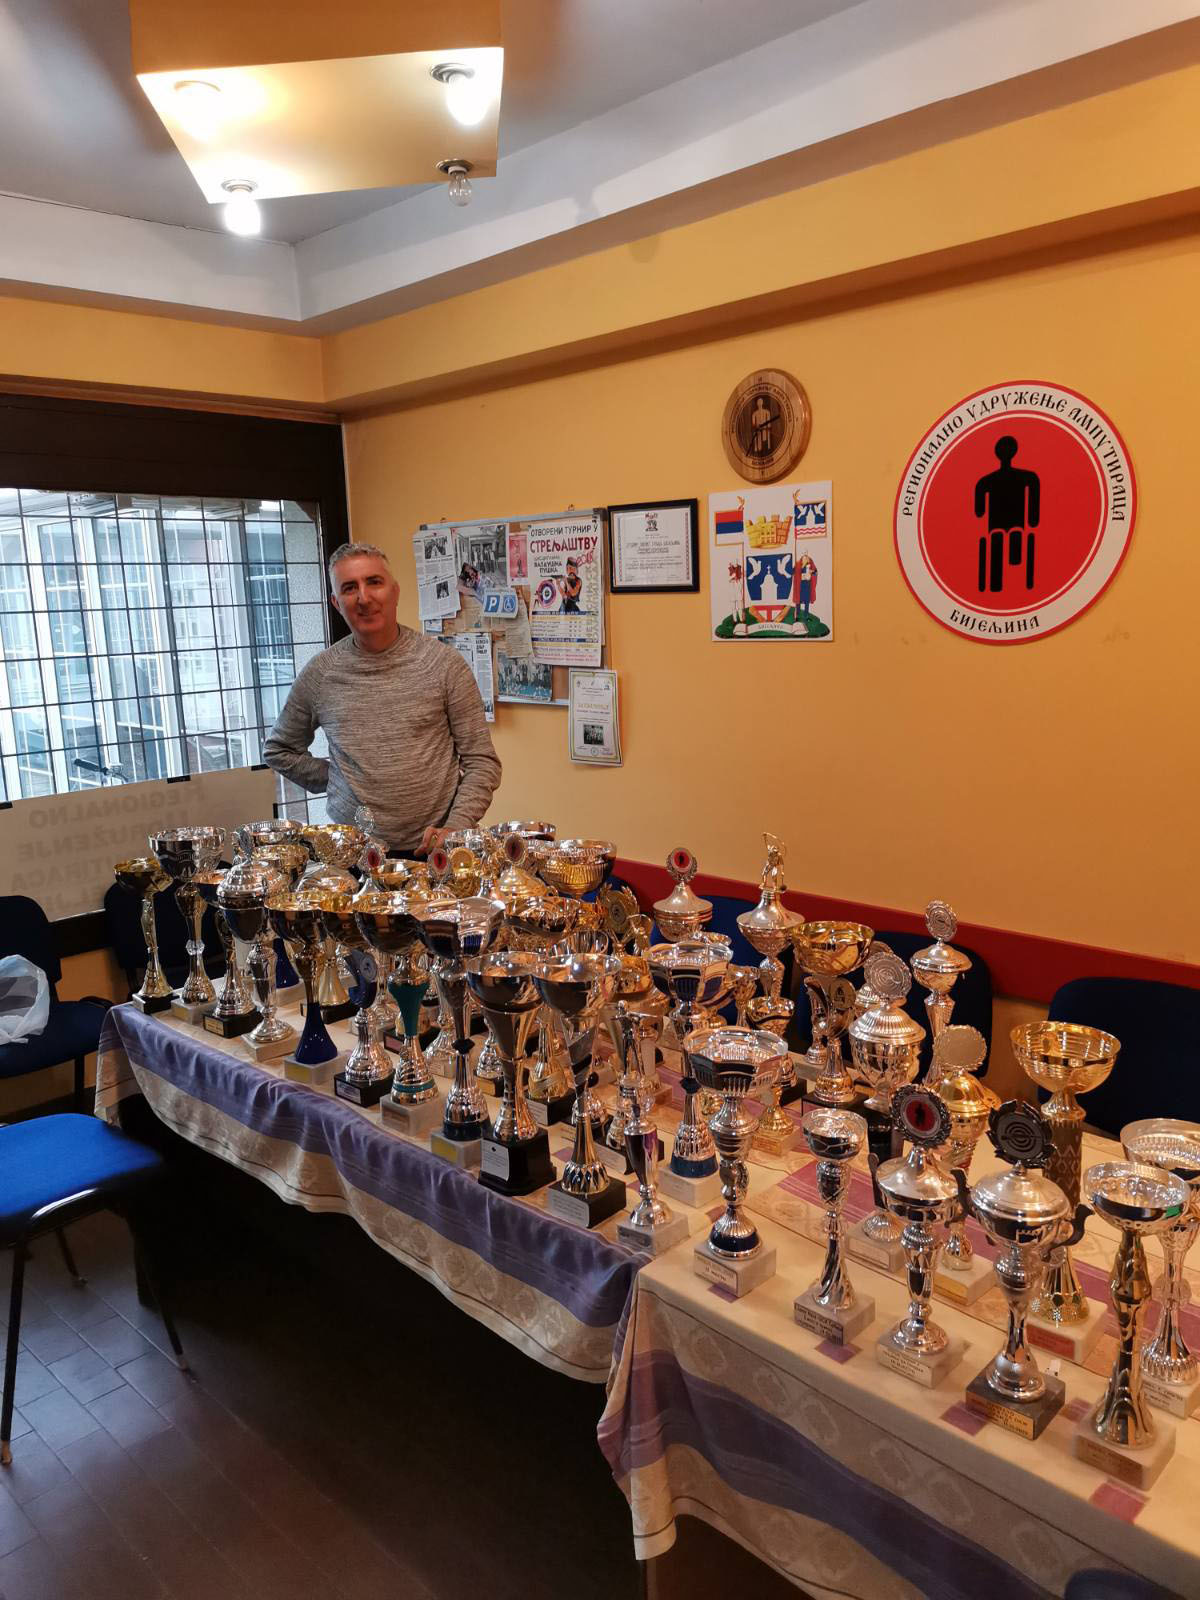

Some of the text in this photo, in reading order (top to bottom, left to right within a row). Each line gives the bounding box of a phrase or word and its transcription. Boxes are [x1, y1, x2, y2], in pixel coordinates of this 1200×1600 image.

[902, 391, 1127, 522] РЕГИОНАЛНО УДРУЖЕЊЕ АМПУТИРАЦА
[530, 528, 563, 537] ОТВОРЕНИ
[565, 525, 592, 535] ТУРНИР
[530, 536, 598, 553] СТРЕЉАШТВУ
[487, 596, 498, 612] P
[949, 609, 1041, 635] БИЈЕЉИНА
